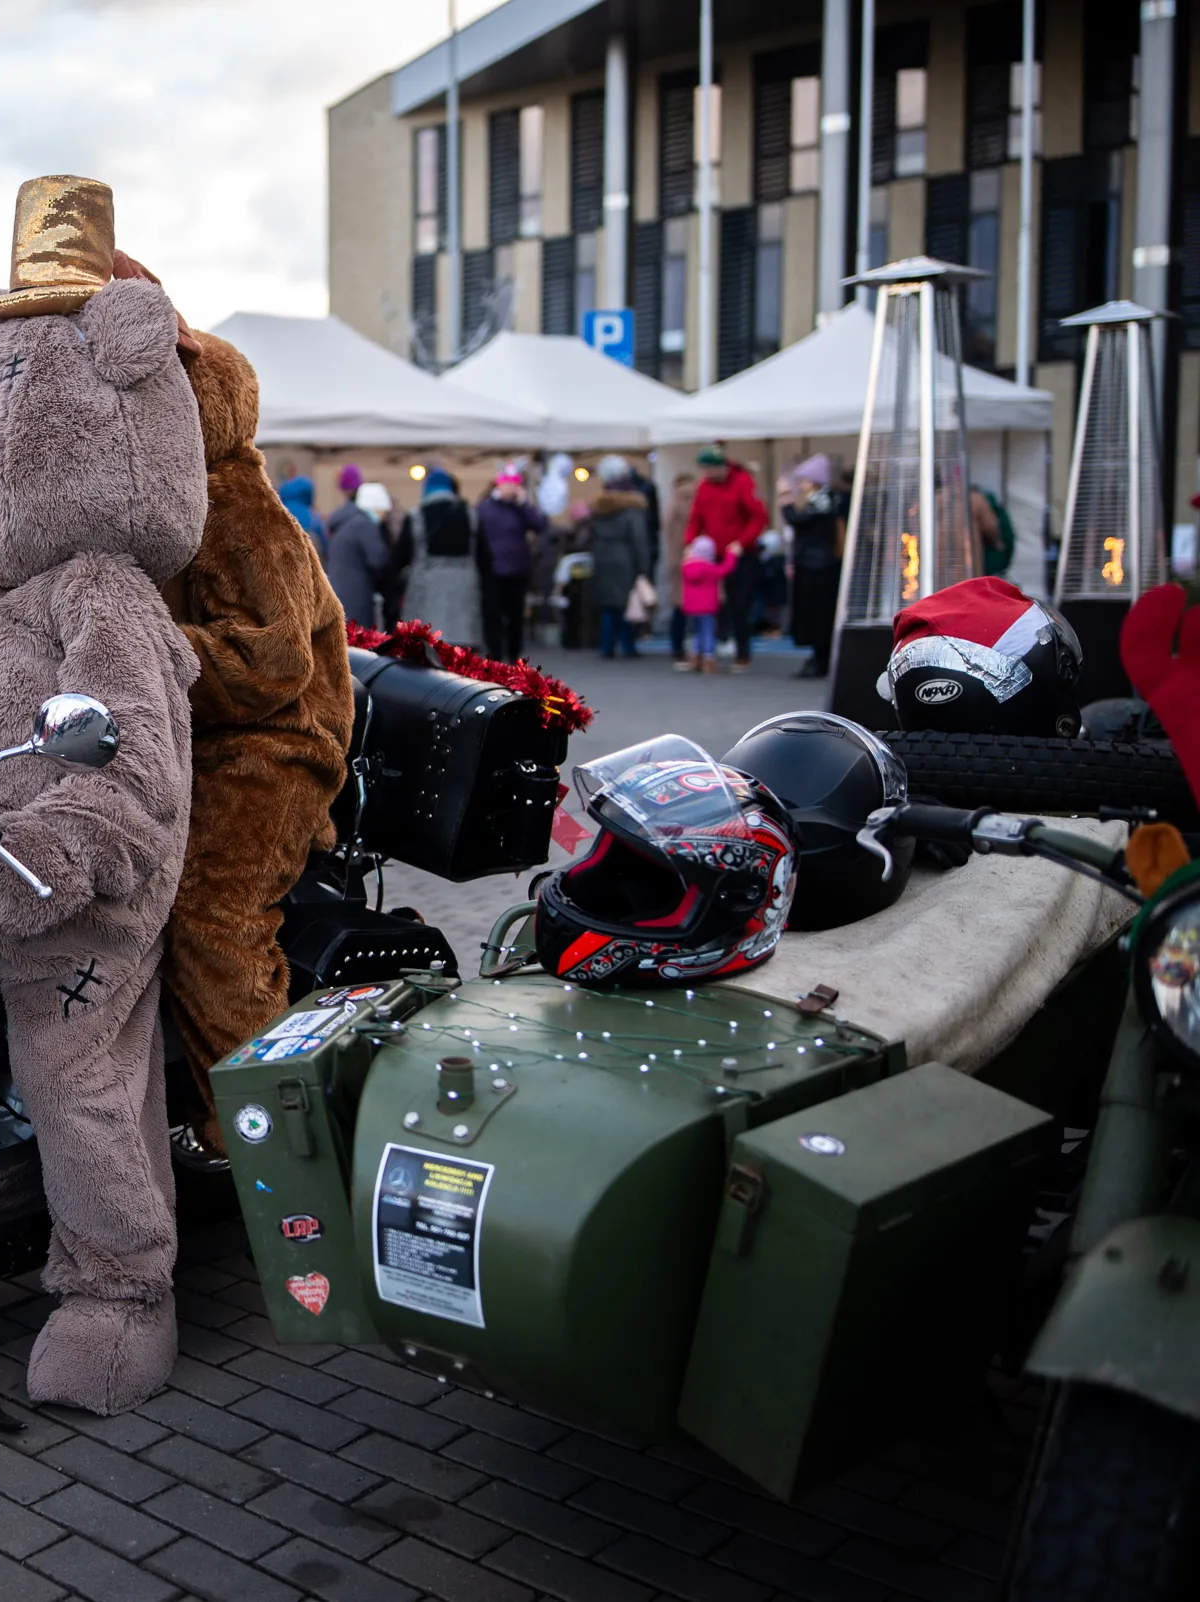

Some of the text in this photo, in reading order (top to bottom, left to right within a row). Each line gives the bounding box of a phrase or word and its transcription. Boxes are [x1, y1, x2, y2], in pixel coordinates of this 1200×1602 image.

[594, 316, 624, 353] P
[920, 684, 957, 699] NAXA
[282, 1219, 319, 1238] LAP
